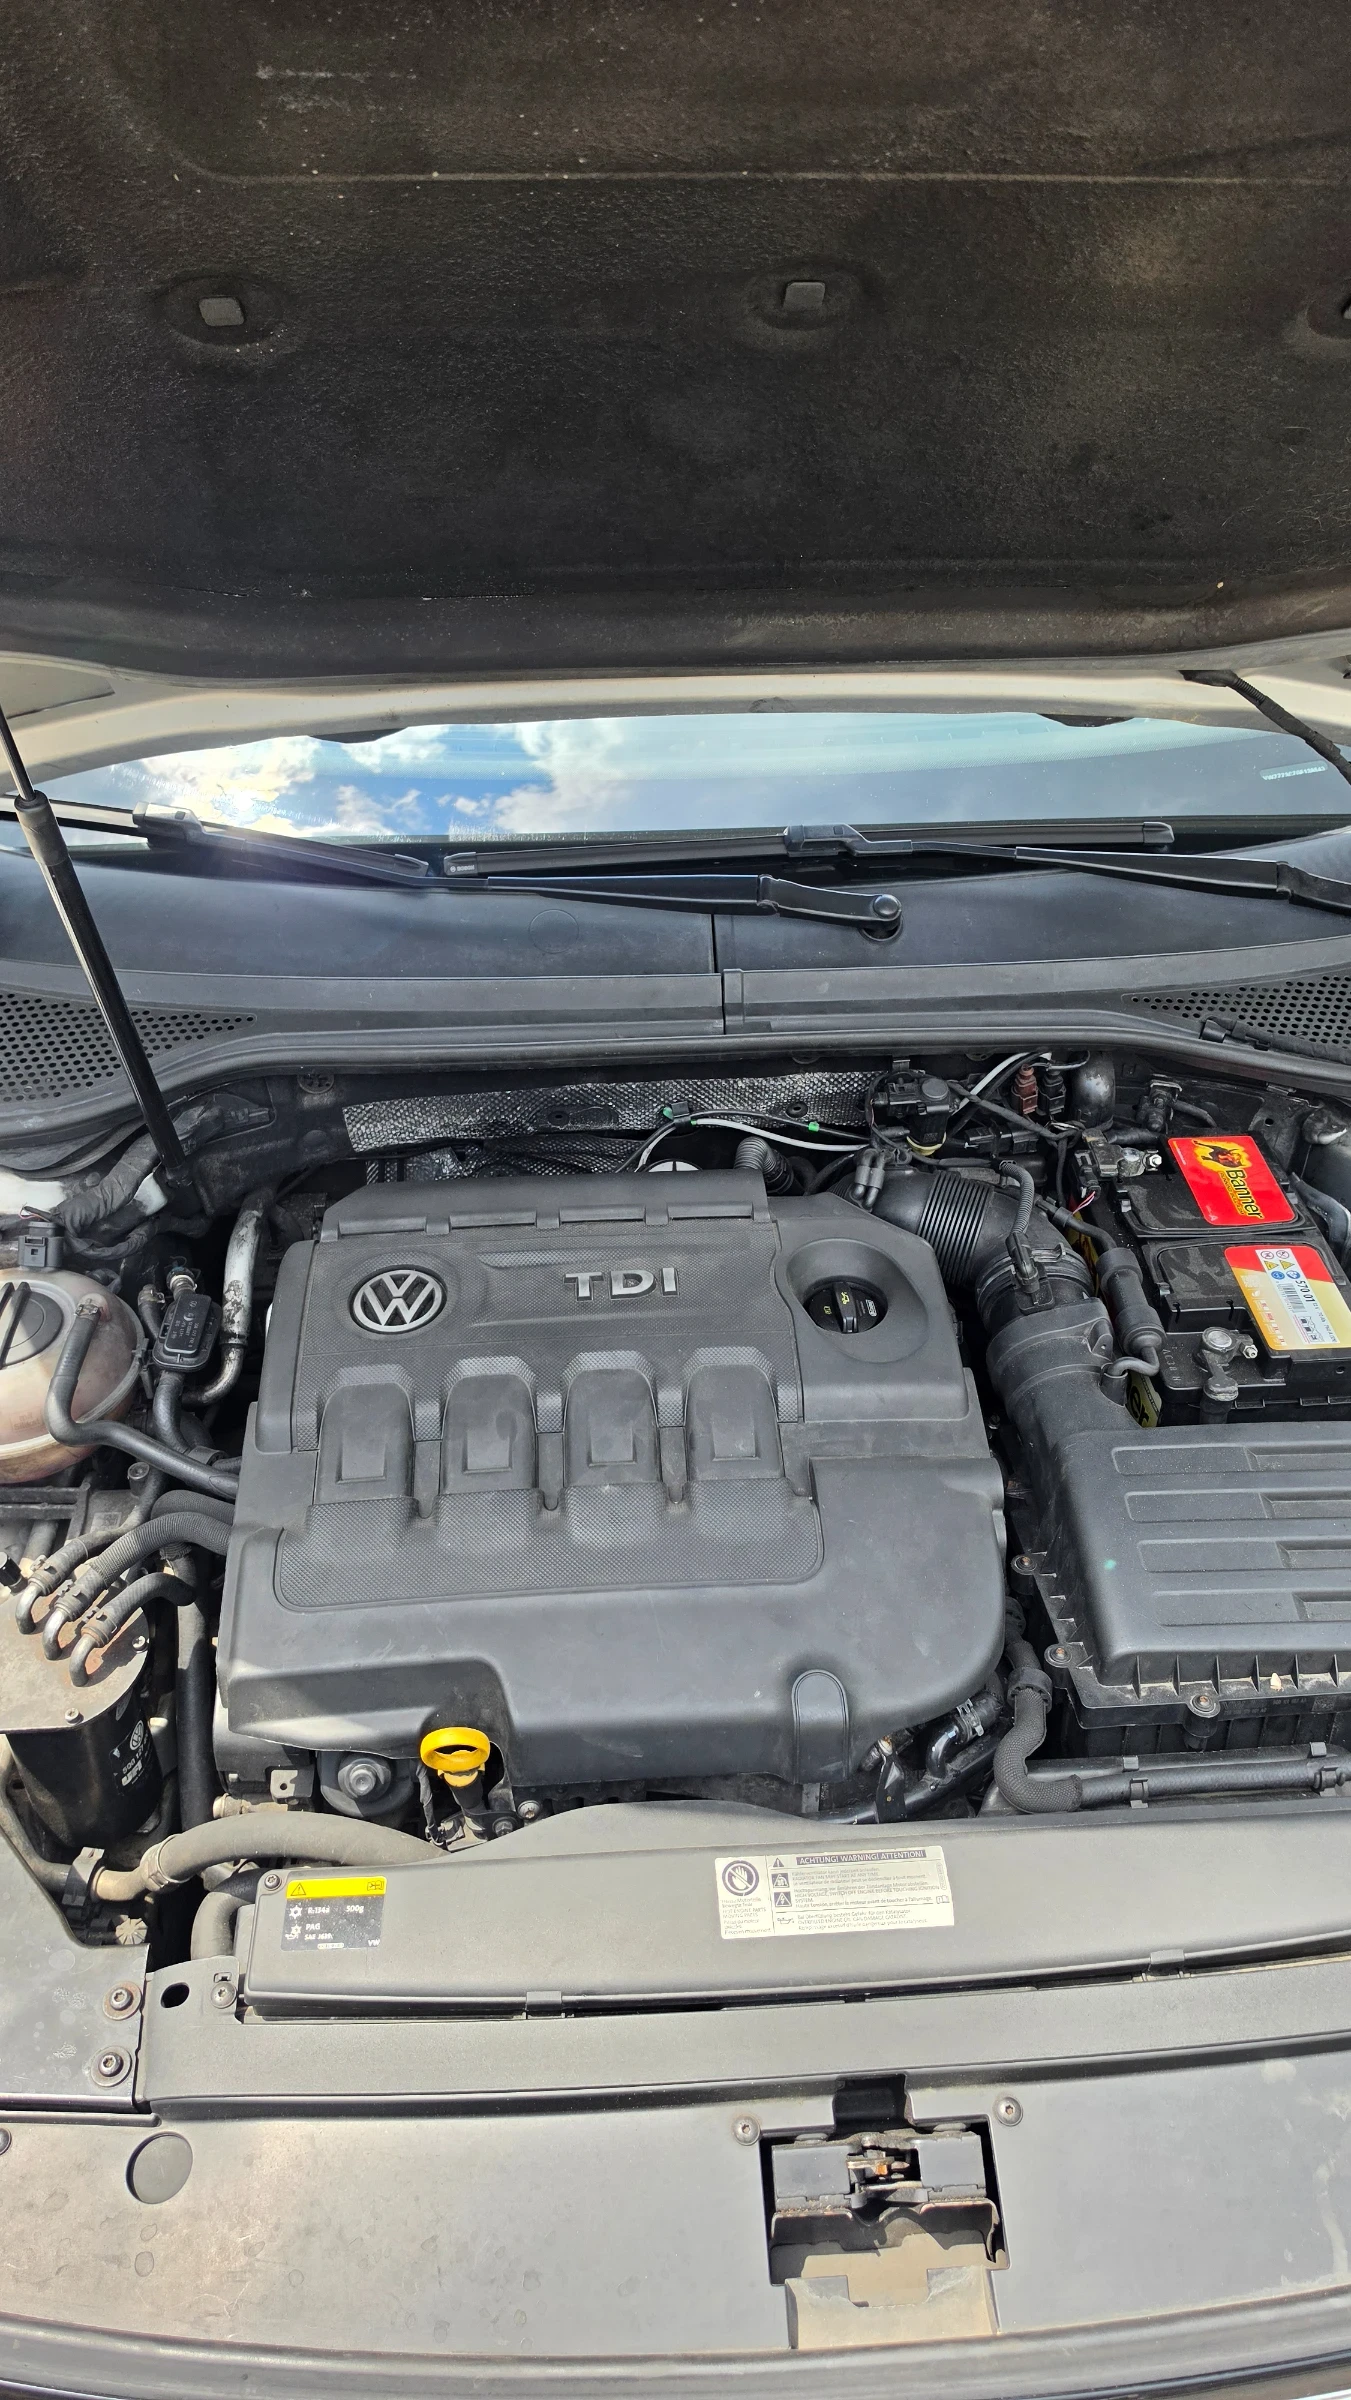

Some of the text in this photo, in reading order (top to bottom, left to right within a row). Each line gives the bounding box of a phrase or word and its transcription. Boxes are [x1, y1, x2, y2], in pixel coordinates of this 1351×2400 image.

[1225, 1168, 1264, 1218] Banner
[564, 1267, 679, 1301] TDI
[1295, 1280, 1316, 1303] 570 01
[799, 1851, 924, 1864] ACHTUNG! WARNING! ATTENTION!
[345, 1904, 365, 1914] 500g
[305, 1923, 320, 1931] PAG
[368, 1939, 380, 1947] VW
